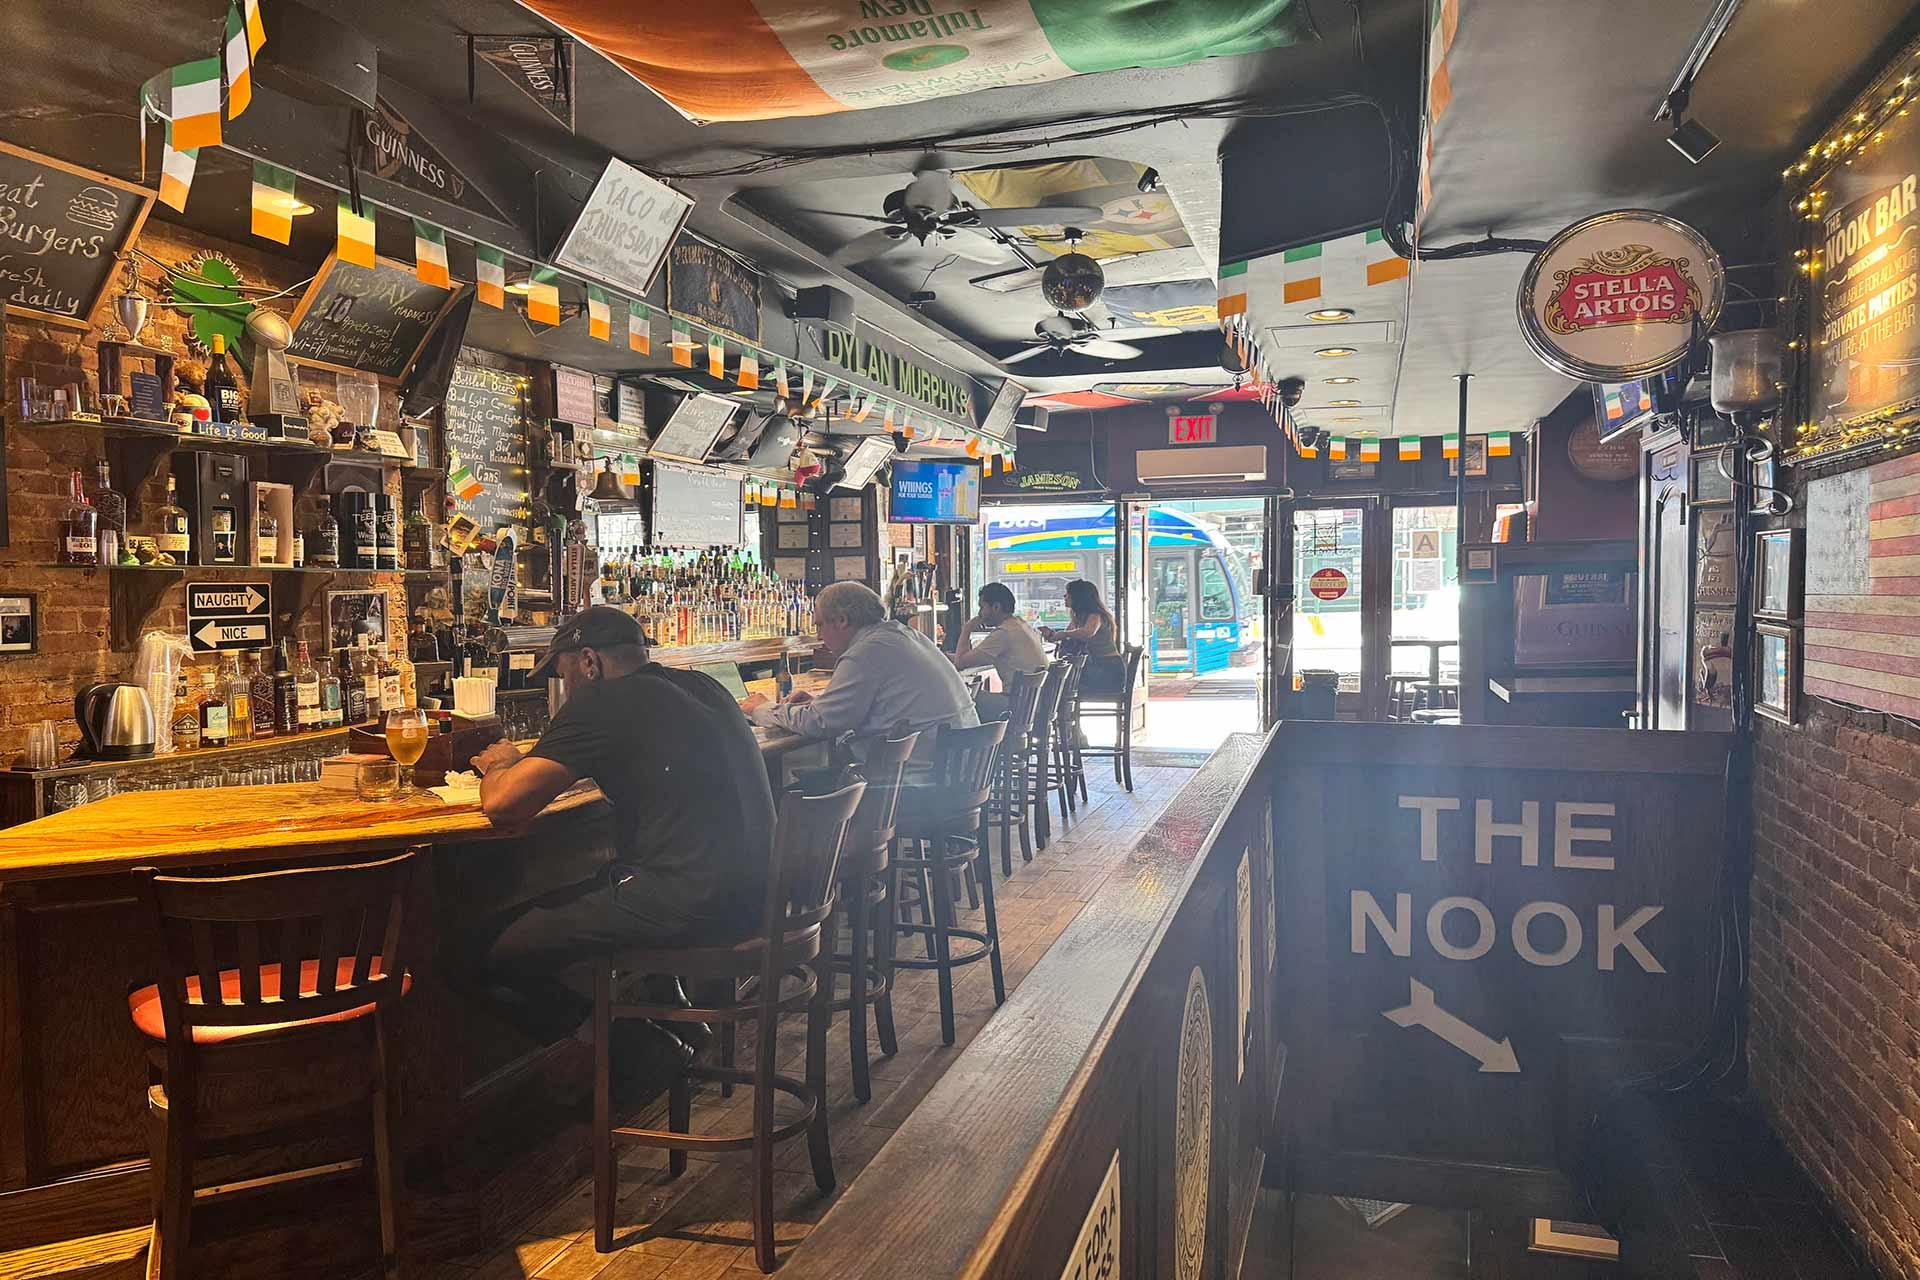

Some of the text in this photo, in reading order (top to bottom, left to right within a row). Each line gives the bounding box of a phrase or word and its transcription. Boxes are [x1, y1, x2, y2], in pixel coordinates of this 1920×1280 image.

[826, 9, 992, 51] Tullamore
[509, 43, 555, 90] GUINNESS
[366, 120, 446, 189] GUINNESS
[606, 177, 655, 217] TACO
[585, 208, 662, 261] THURSDAY
[1826, 211, 1841, 236] THE
[1826, 174, 1917, 273] NOOK BAR
[1574, 275, 1674, 300] STELLA
[1864, 274, 1881, 298] FOR
[1880, 267, 1895, 289] ALL
[1893, 247, 1917, 278] YOUR
[11, 286, 79, 315] daily
[335, 269, 416, 311] TUESDAY
[394, 306, 437, 327] MADNESS
[1574, 294, 1676, 319] ARTOIS
[1825, 272, 1917, 342] PRIVATE PARTIES
[1858, 328, 1873, 350] AT
[1871, 318, 1892, 345] THE
[1894, 303, 1916, 336] BAR
[455, 371, 486, 388] Bottled
[828, 330, 968, 419] DYLAN MURPHY'S
[221, 389, 239, 402] BIG
[199, 421, 266, 441] Life Is Good
[1175, 416, 1213, 441] EXIT
[477, 463, 499, 484] Cans
[1019, 473, 1081, 489] JAMESON
[1417, 534, 1435, 551] A
[491, 559, 506, 589] KONA
[570, 548, 578, 603] STELLA ARTOIS
[196, 593, 253, 607] NAUGHTY
[1698, 586, 1736, 597] GUINNESS
[221, 627, 248, 640] NICE
[1399, 795, 1616, 870] THE
[1350, 890, 1666, 974] NOOK
[1086, 1187, 1116, 1280] FOR A
